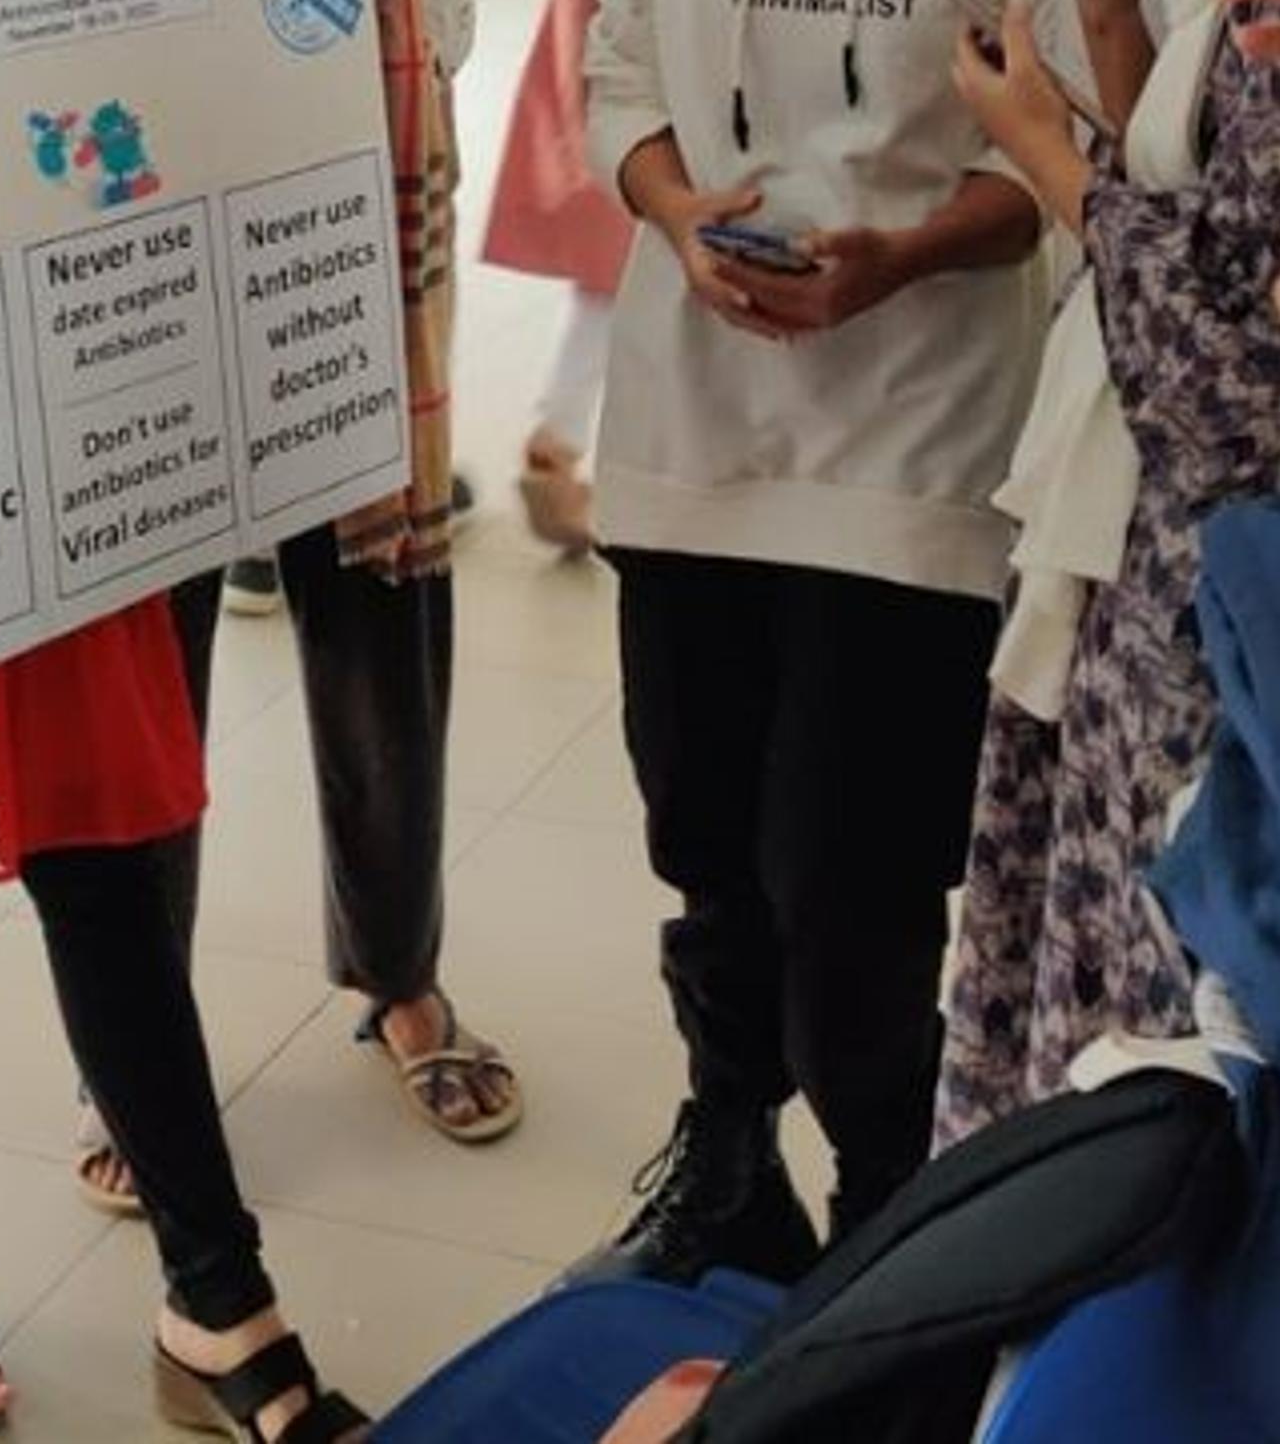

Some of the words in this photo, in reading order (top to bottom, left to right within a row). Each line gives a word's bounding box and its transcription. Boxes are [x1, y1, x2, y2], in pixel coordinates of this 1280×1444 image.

[245, 207, 318, 250] Never
[326, 194, 367, 226] use
[47, 237, 135, 288] Never
[143, 223, 193, 258] use
[245, 242, 377, 302] Antibiotics
[52, 300, 106, 336] date
[113, 267, 198, 315] expired
[267, 293, 365, 350] without
[74, 319, 187, 371] Antibiotics
[270, 341, 369, 402] doctor's
[81, 416, 149, 460] Don't
[154, 403, 195, 434] use
[248, 386, 398, 472] prescription
[61, 448, 185, 514] antibiotics
[189, 434, 221, 462] for
[62, 510, 130, 562] Viral
[133, 481, 228, 537] diseases
